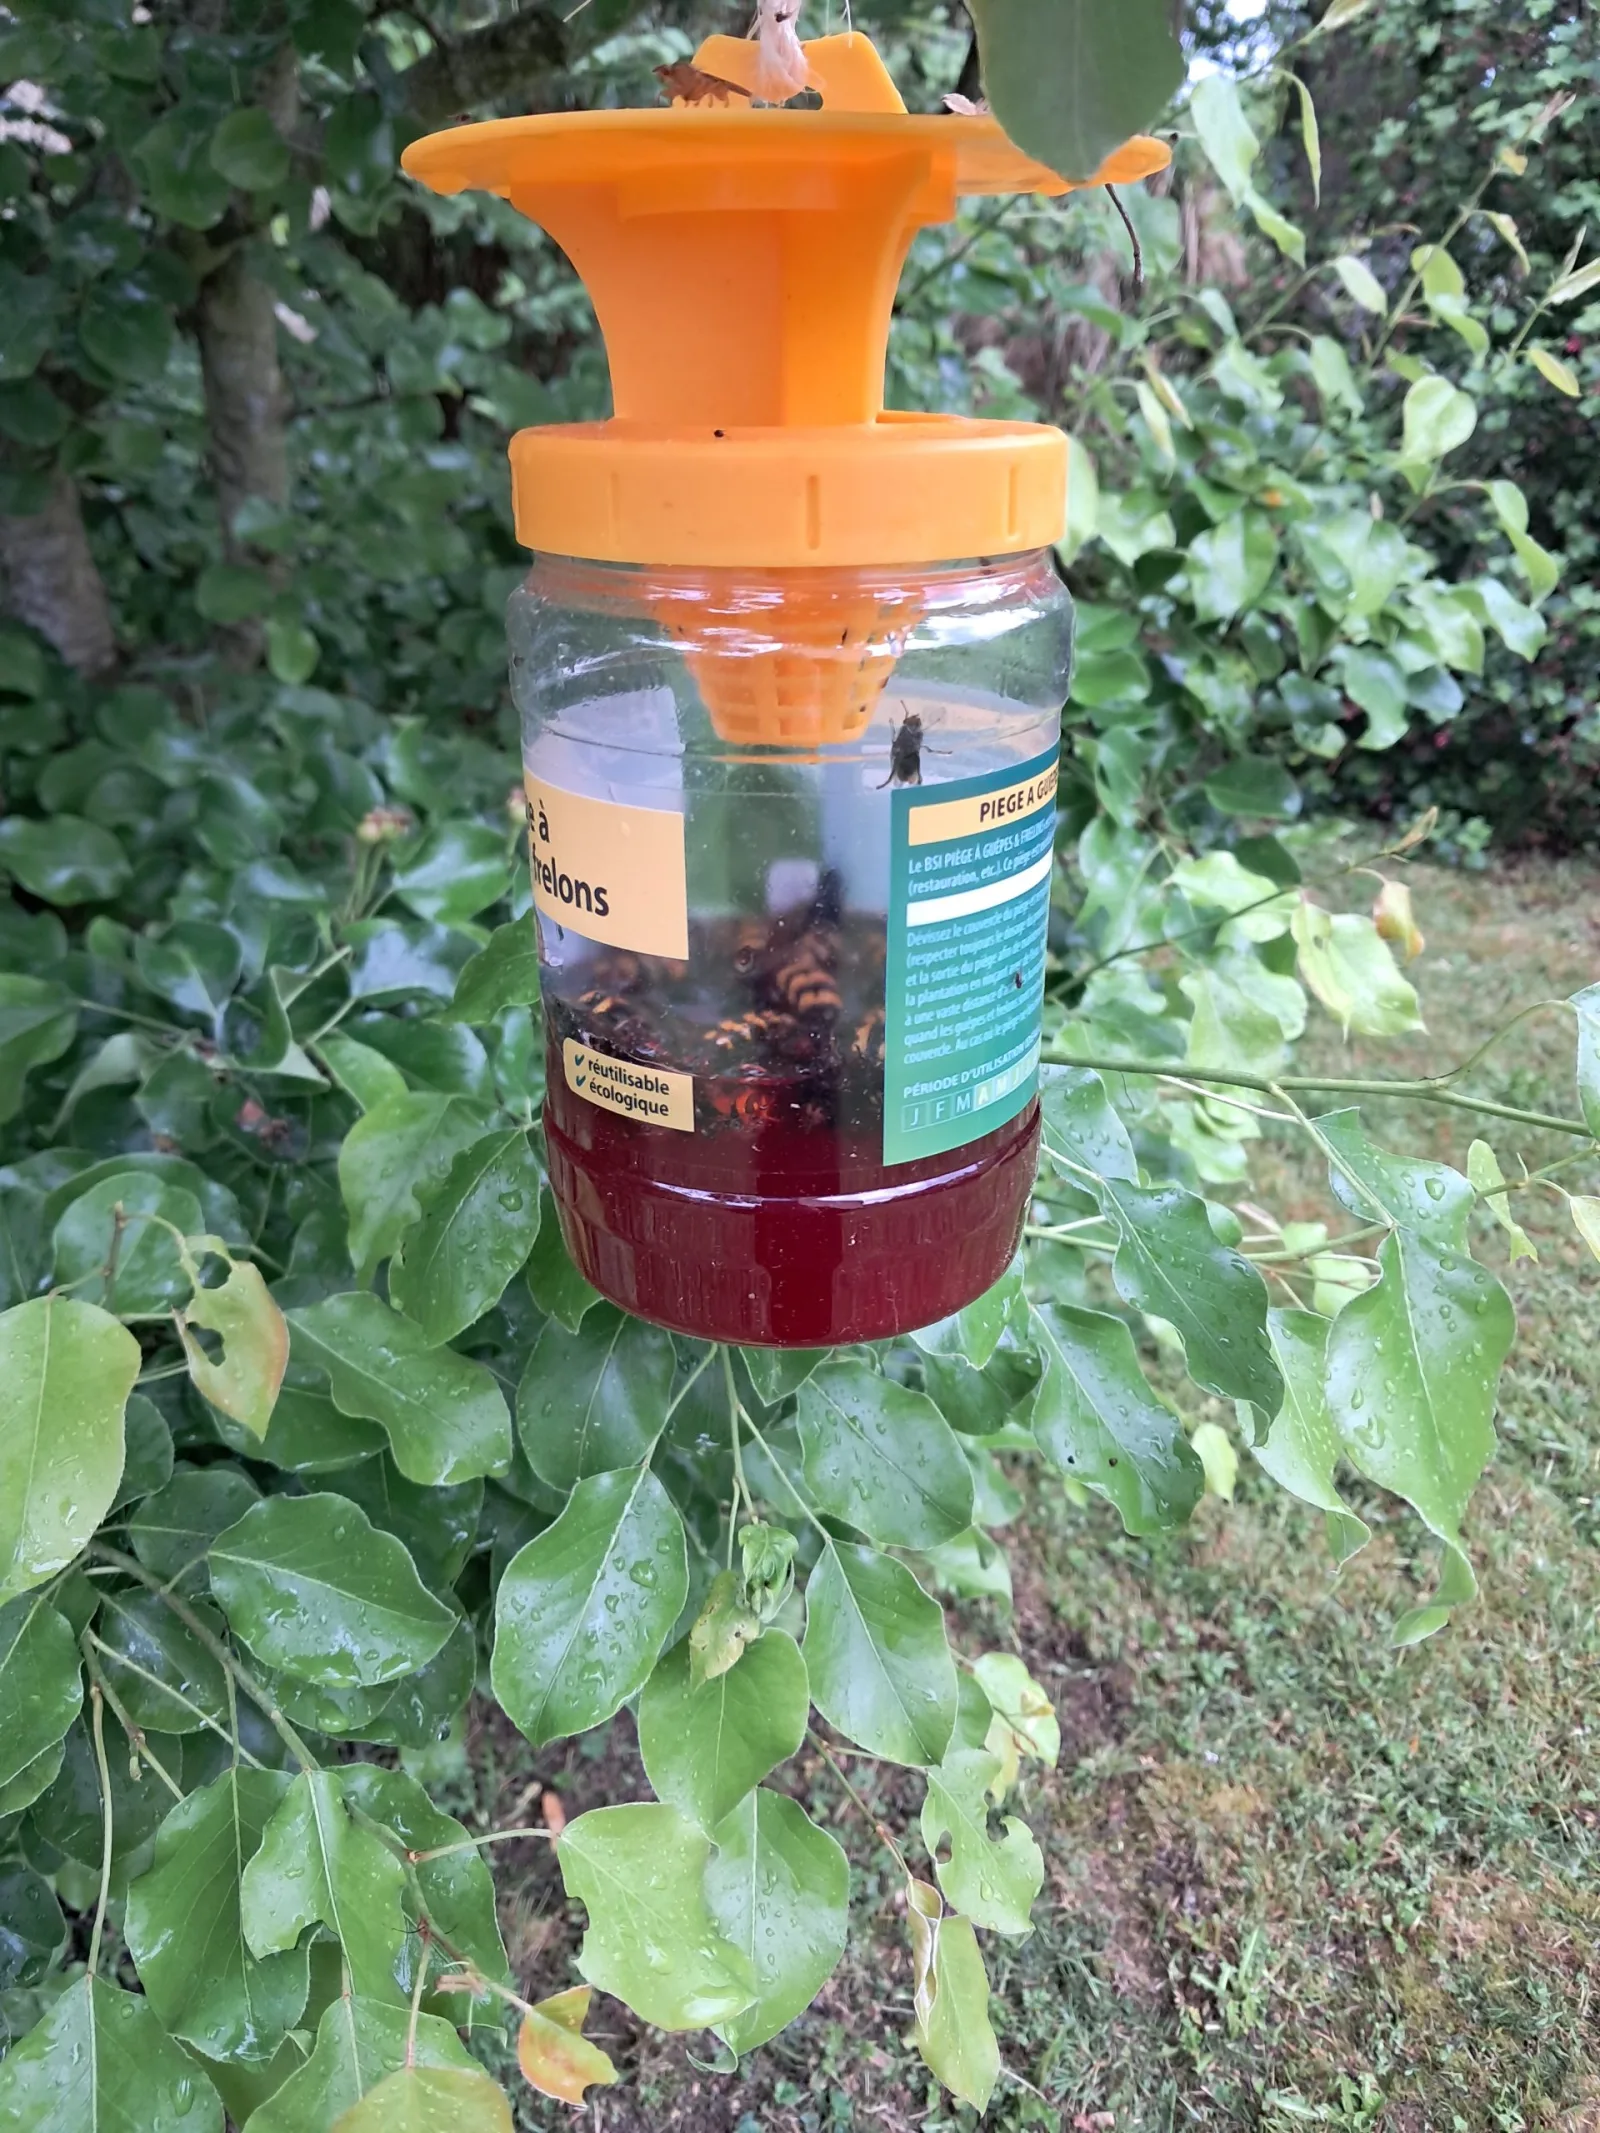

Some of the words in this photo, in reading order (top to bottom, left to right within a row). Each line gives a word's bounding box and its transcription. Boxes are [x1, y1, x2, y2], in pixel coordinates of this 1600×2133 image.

[539, 799, 550, 843] à
[980, 790, 1024, 823] PIEGE
[1026, 786, 1035, 806] A
[908, 858, 922, 875] Le
[924, 854, 942, 872] BSI
[588, 1058, 670, 1096] réutilisable
[903, 1073, 959, 1099] PÉRIODE
[589, 1077, 670, 1117] écologique
[956, 1092, 971, 1113] M
